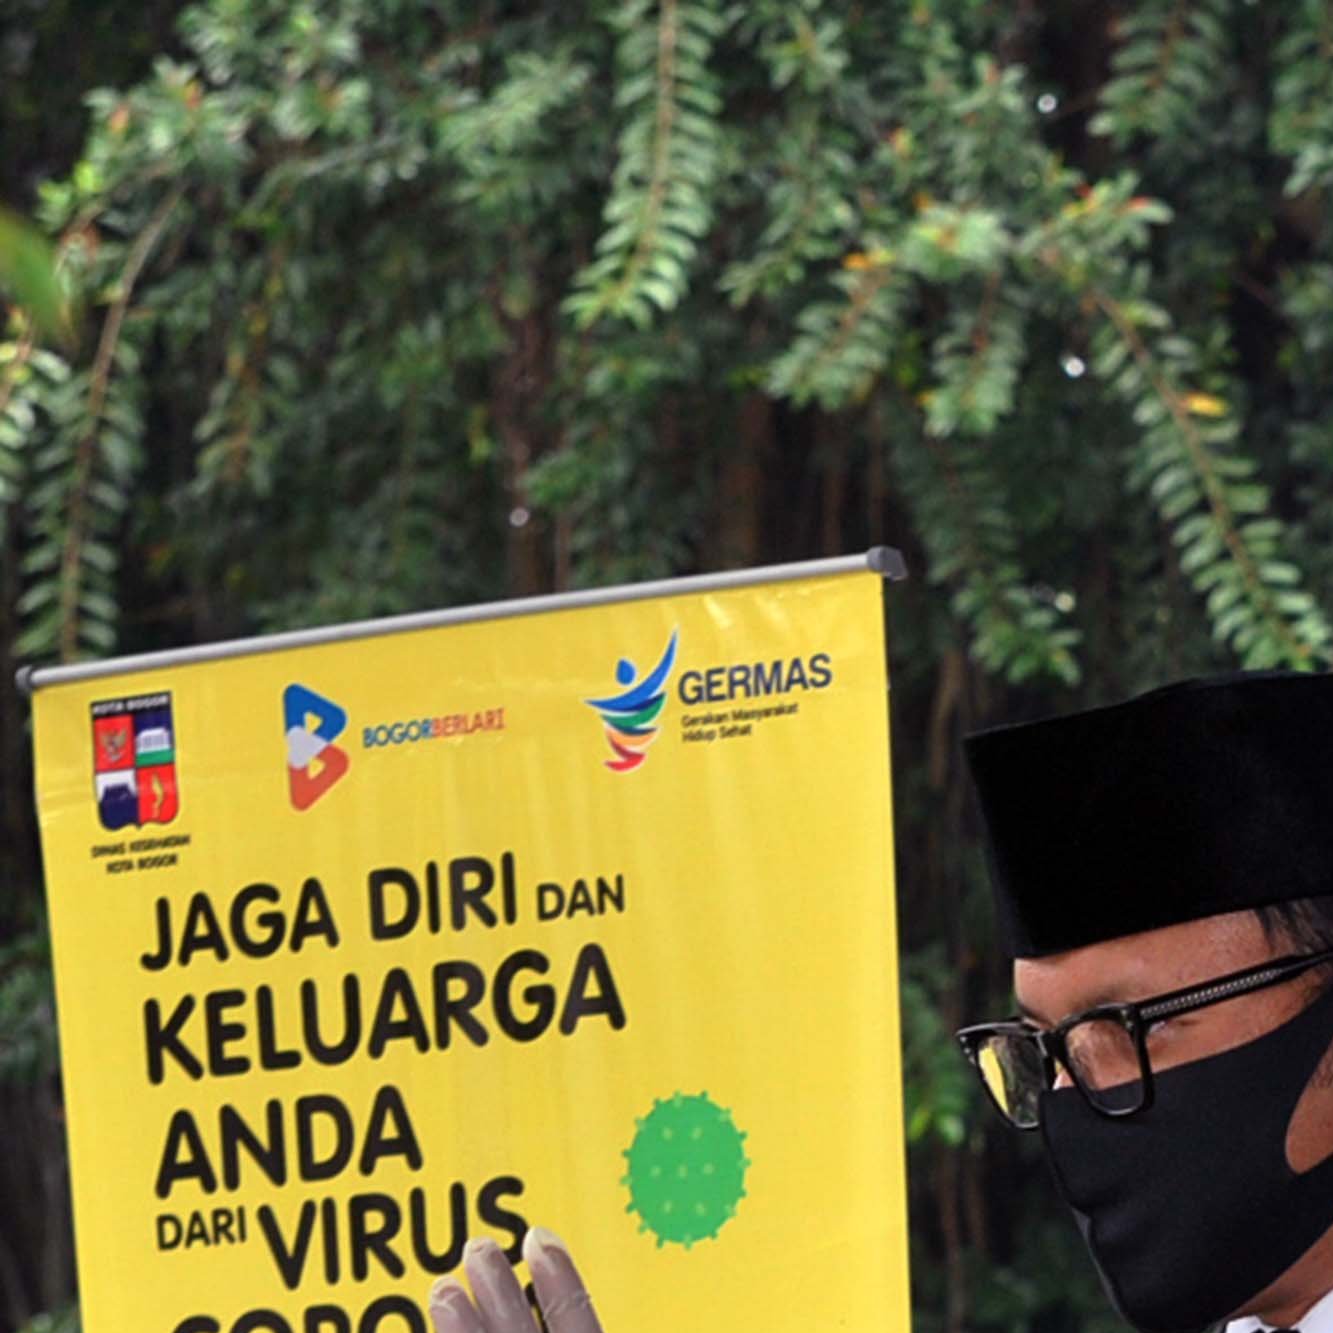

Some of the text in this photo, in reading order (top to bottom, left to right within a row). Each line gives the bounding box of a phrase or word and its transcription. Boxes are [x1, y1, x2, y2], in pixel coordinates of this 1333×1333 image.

[678, 653, 832, 705] GERMAS
[681, 703, 799, 729] Gerakan Masyarakat
[362, 708, 506, 749] BOGORBERLARI
[682, 723, 752, 743] Hidup Sehat
[139, 852, 625, 971] JAGA DIRI DAN
[143, 942, 626, 1085] KELUARGA
[154, 1084, 424, 1199] ANDA
[156, 1176, 528, 1291] DARI VIRUS
